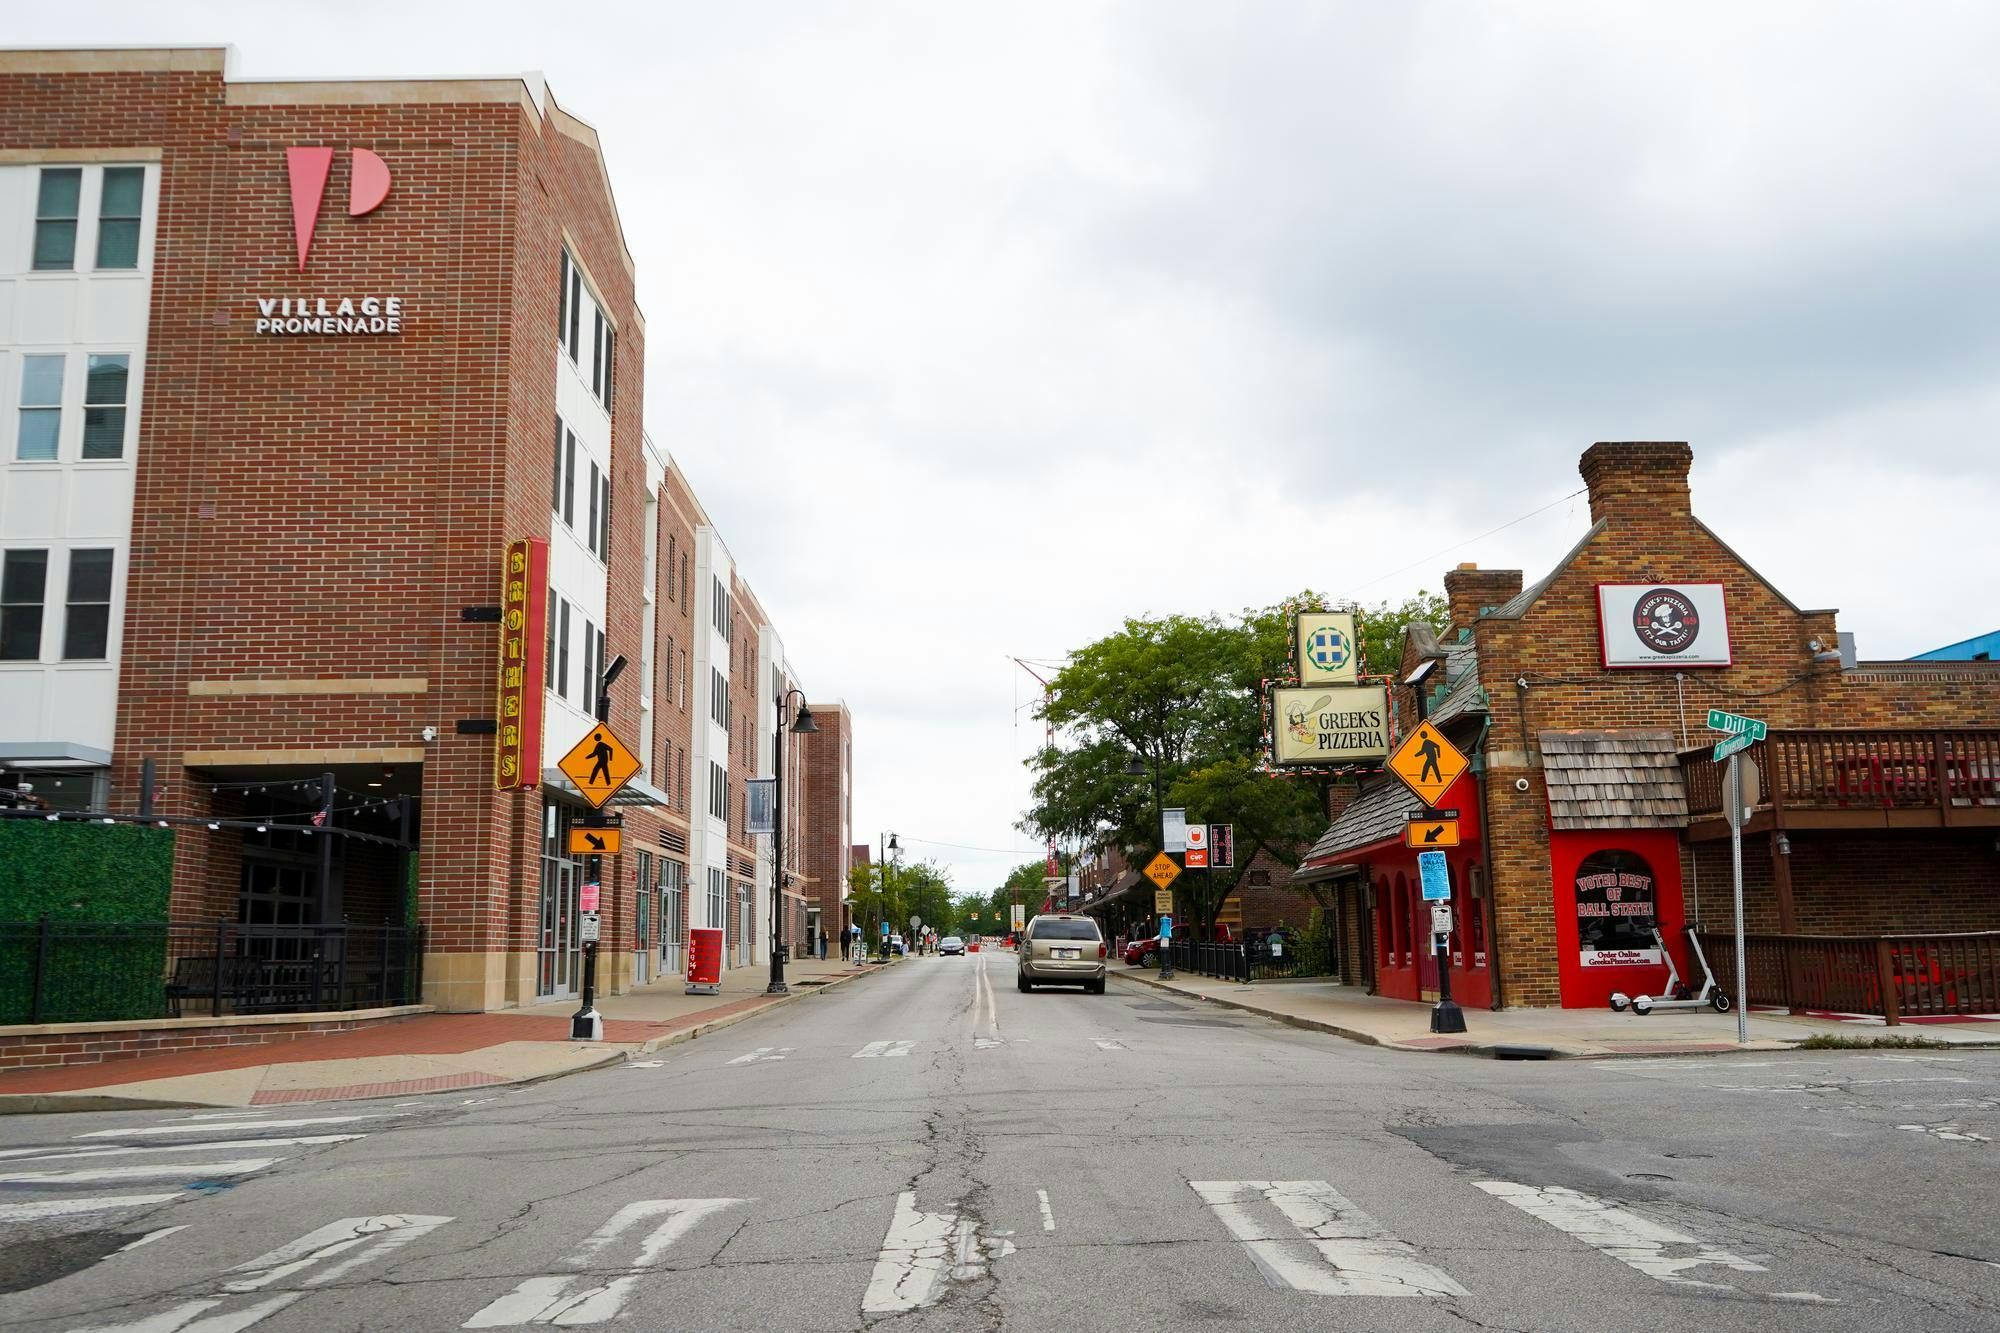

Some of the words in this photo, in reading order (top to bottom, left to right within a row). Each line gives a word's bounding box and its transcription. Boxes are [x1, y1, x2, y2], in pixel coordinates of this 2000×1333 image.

[257, 297, 401, 317] VILLAGE
[256, 318, 401, 334] PROMENADE
[1664, 596, 1689, 616] PIZZERIA
[502, 552, 524, 777] BROTHERS
[1319, 711, 1380, 730] GREEK'S
[1714, 713, 1719, 722] N
[1724, 715, 1746, 733] Dill
[1318, 731, 1385, 749] PIZZERIA
[1154, 863, 1171, 871] STOP
[1576, 873, 1618, 892] VOTED
[1619, 873, 1652, 890] BEST
[1606, 887, 1622, 901] OF
[1577, 903, 1610, 917] BALL
[1611, 902, 1654, 916] STATE!
[1597, 951, 1617, 959] Order
[1618, 950, 1641, 958] Online
